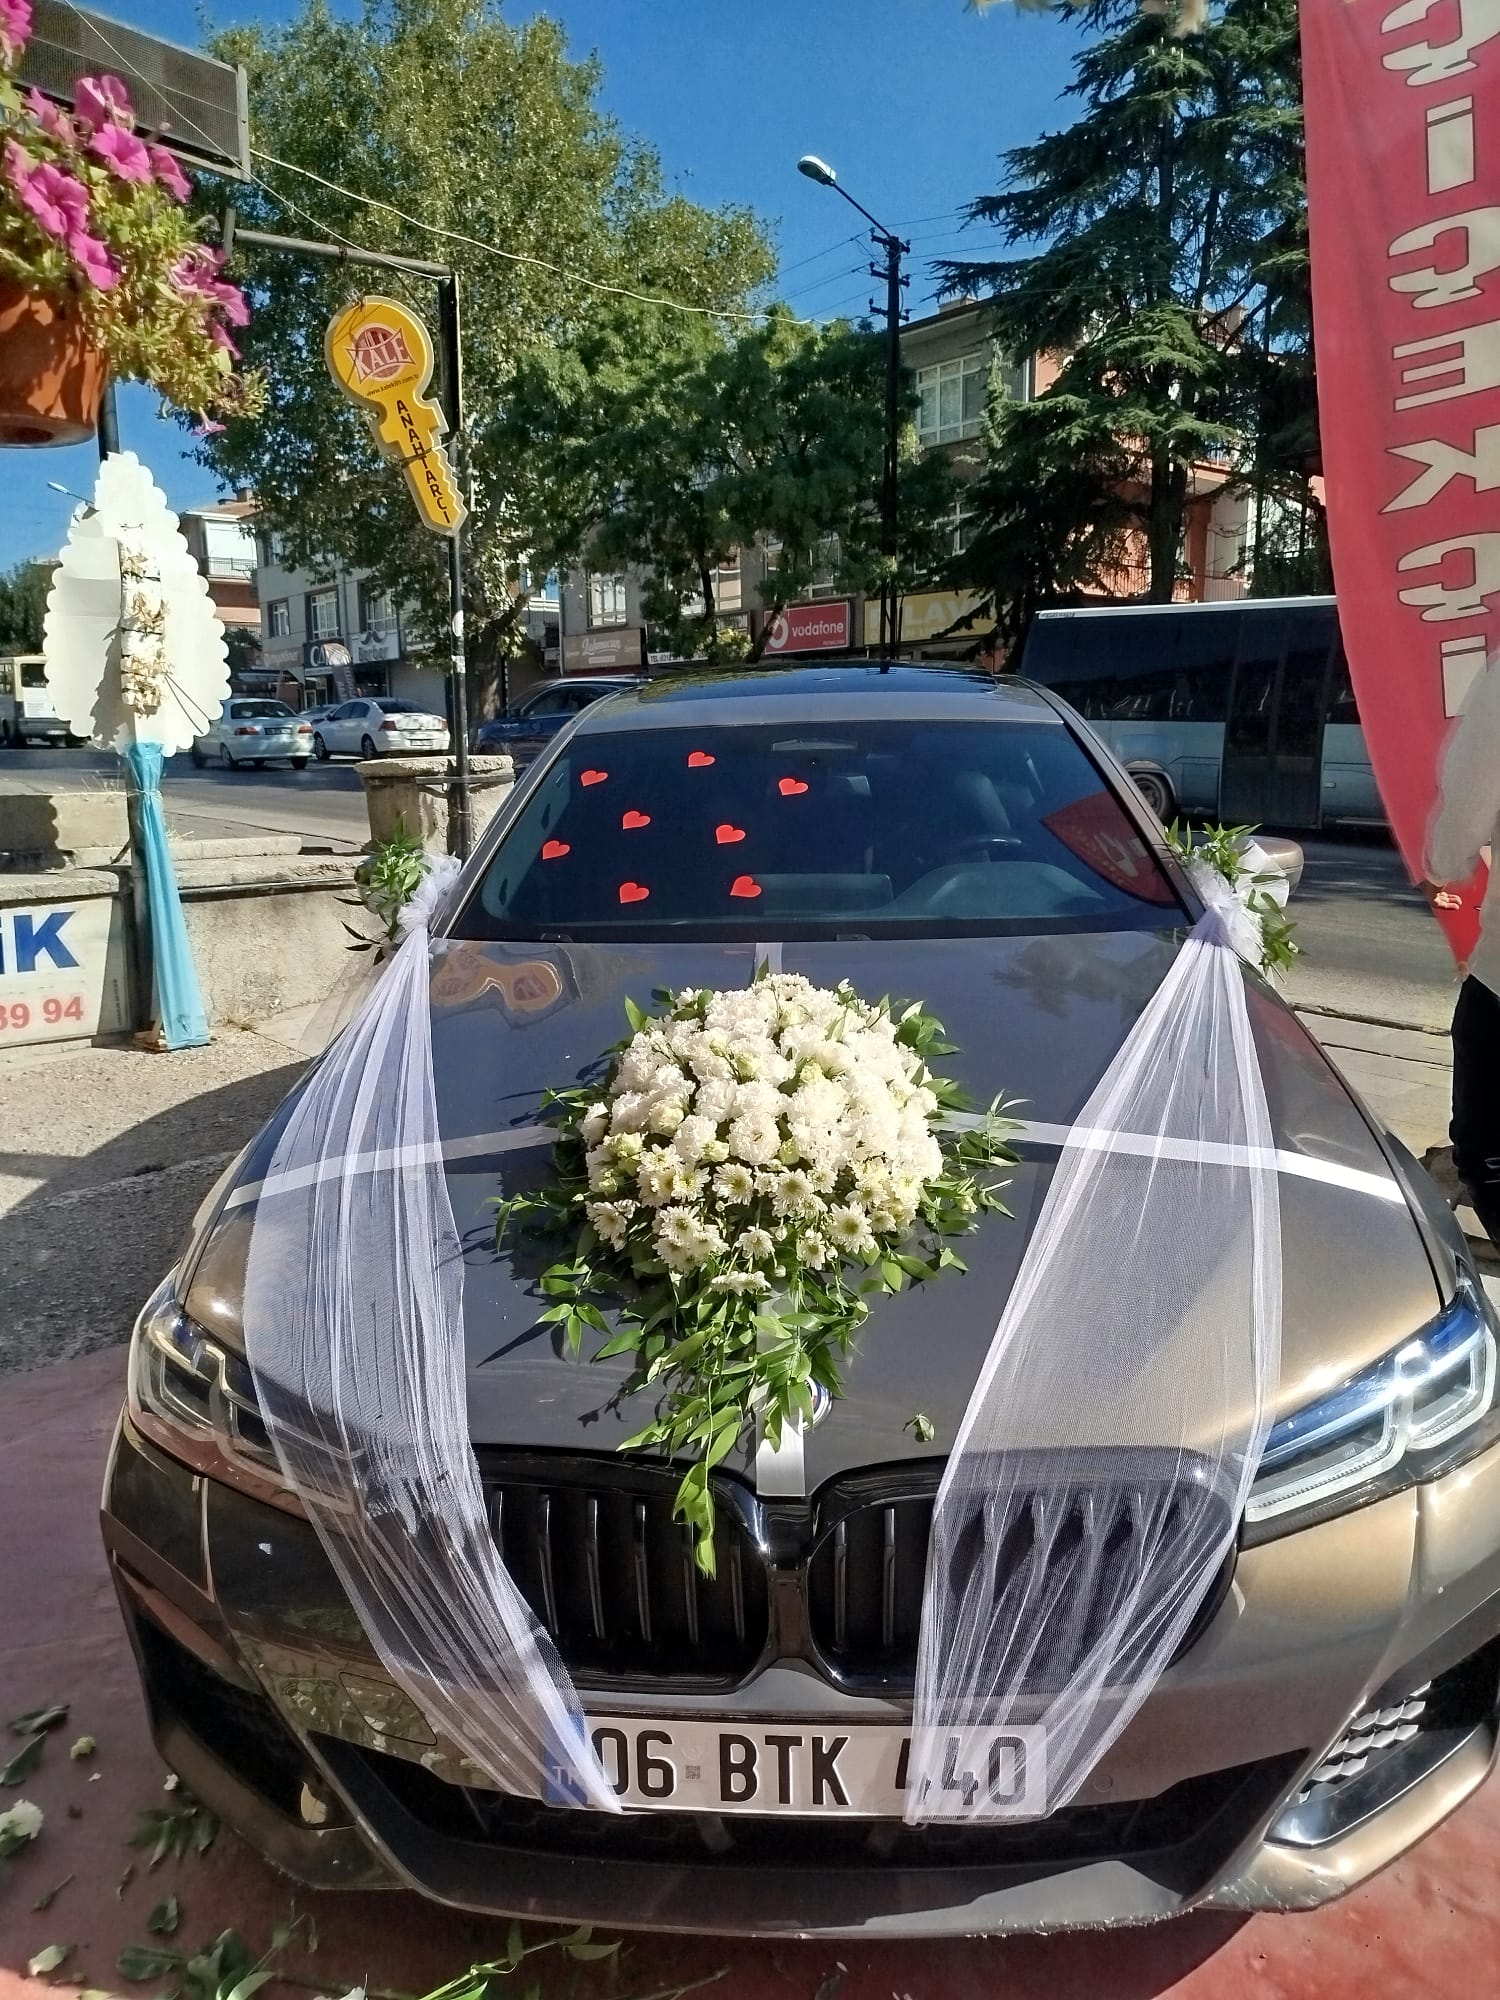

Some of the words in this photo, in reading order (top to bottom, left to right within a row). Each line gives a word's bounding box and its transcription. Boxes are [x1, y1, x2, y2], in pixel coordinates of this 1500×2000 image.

[355, 337, 412, 377] KALE
[396, 400, 450, 524] ANAHTARCI
[791, 620, 844, 638] vodafone
[43, 996, 85, 1024] 94
[591, 1727, 675, 1798] 06
[719, 1731, 851, 1808] BTK
